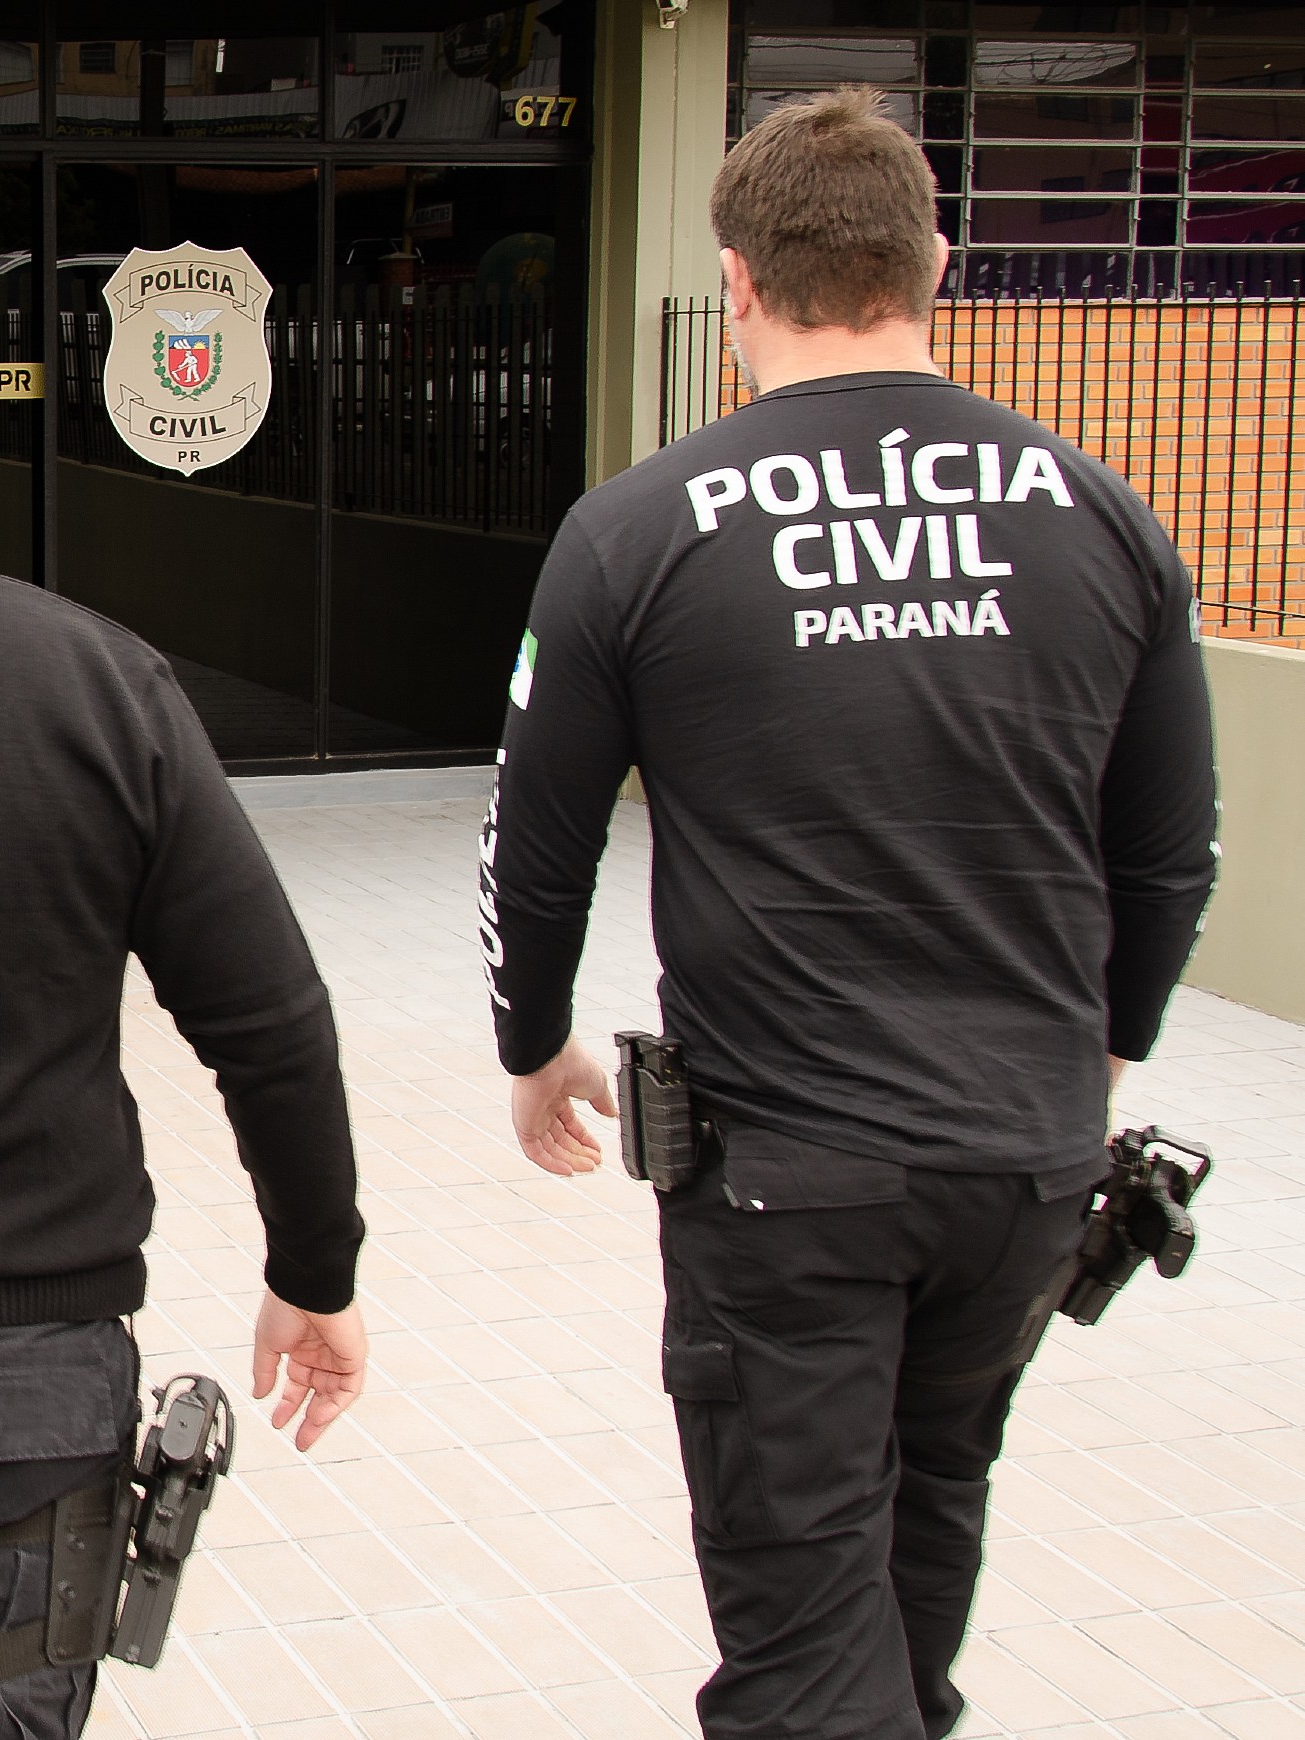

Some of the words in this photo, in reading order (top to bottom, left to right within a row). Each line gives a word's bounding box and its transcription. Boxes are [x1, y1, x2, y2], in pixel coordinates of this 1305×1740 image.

[515, 95, 577, 126] 677
[140, 264, 236, 297] POLÍCIA
[149, 415, 227, 438] CIVIL
[178, 450, 201, 463] PR
[685, 427, 1075, 533] POLÍCIA
[772, 513, 1013, 590] CIVIL
[794, 588, 1011, 648] PARANÁ
